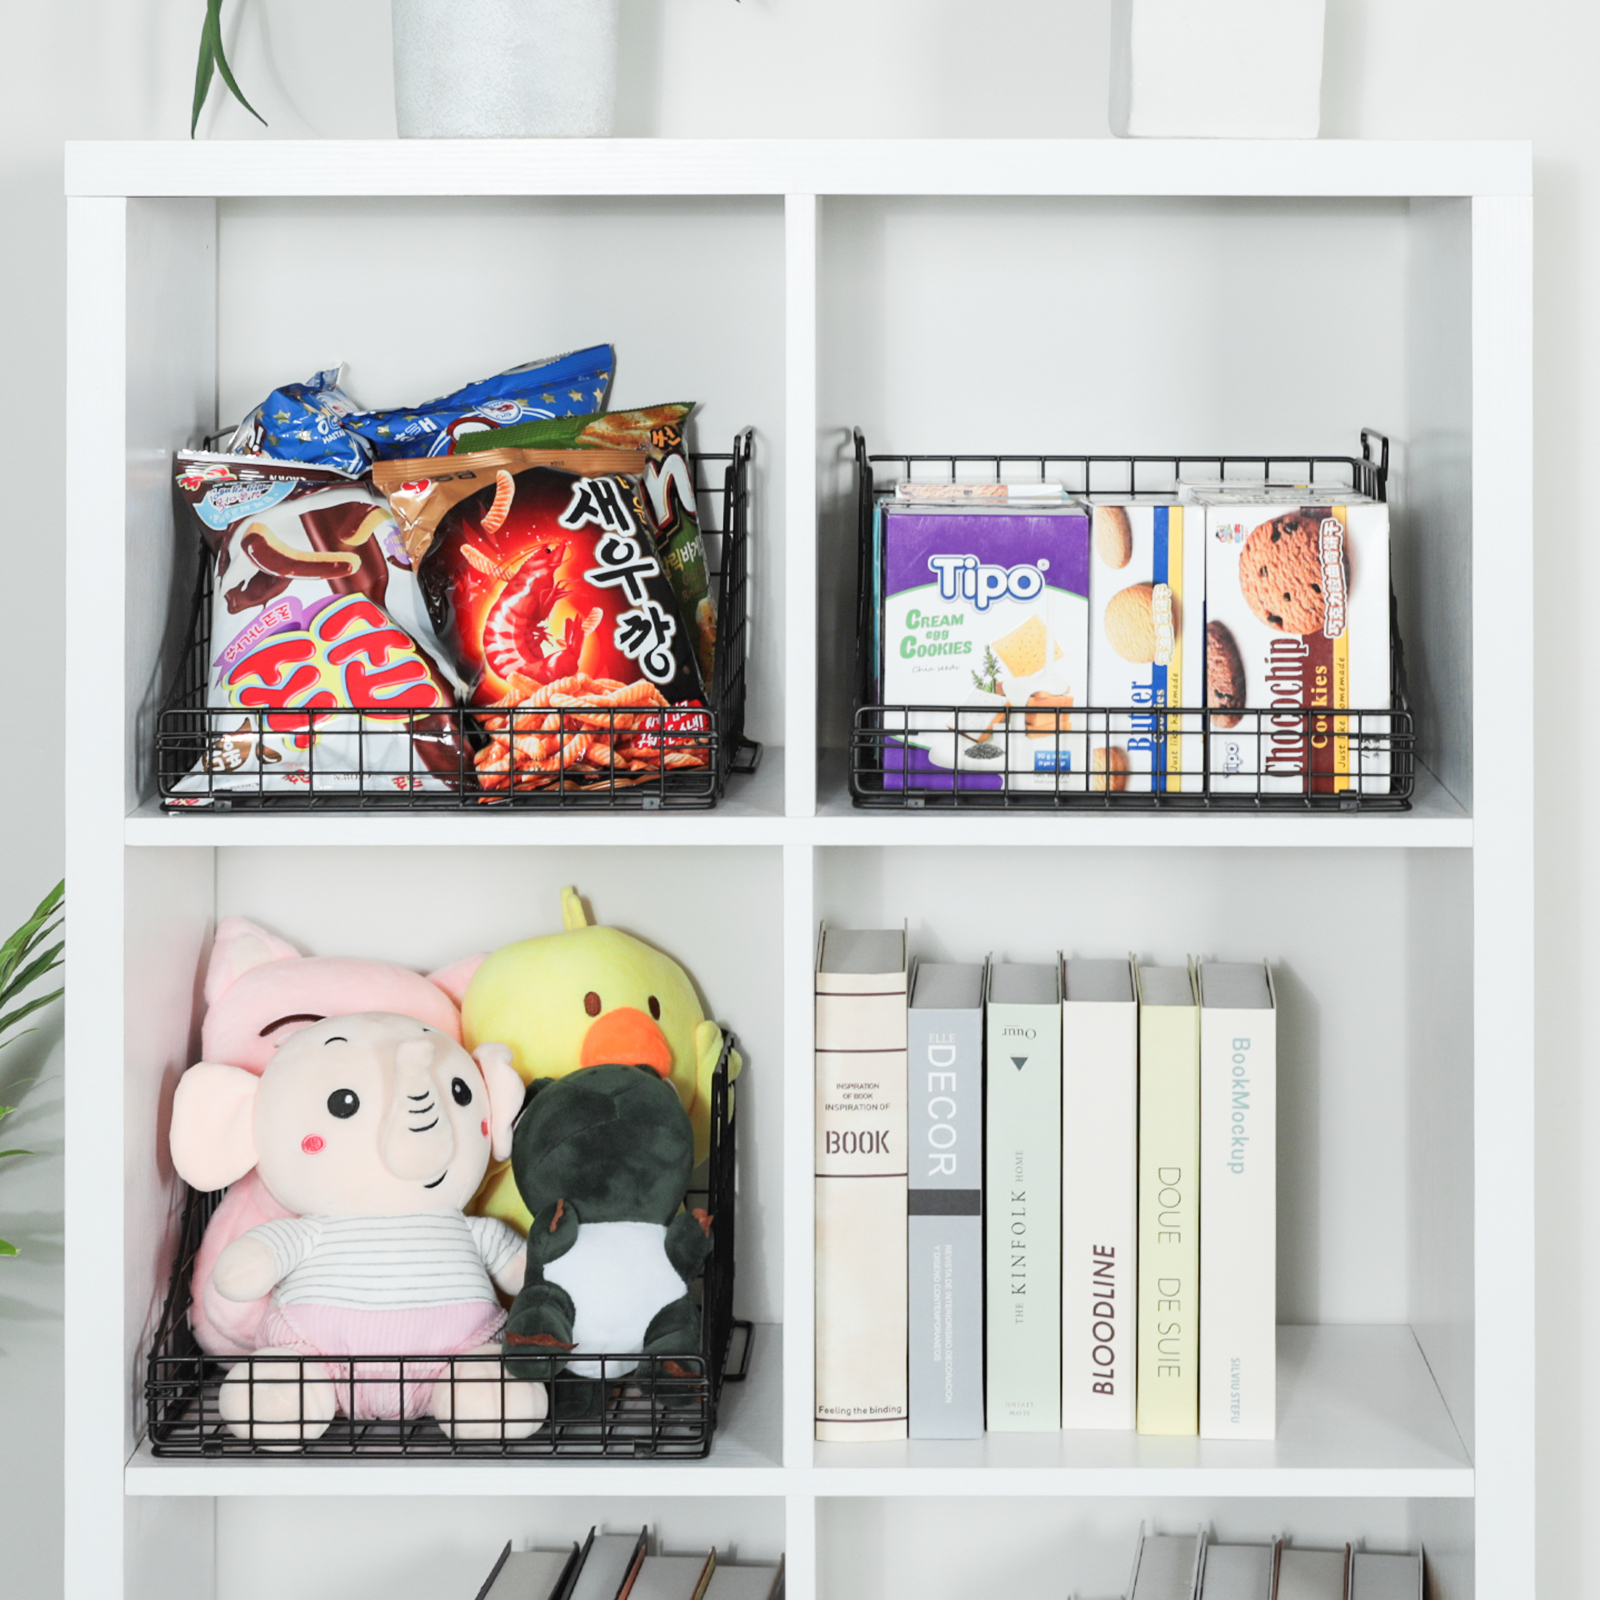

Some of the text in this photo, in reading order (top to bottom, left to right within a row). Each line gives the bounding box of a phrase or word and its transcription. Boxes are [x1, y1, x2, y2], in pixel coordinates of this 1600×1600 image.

[561, 478, 675, 683] 새우깡
[929, 555, 1044, 612] Tipo
[225, 604, 291, 660] 초코가나슈
[926, 629, 949, 640] egg
[225, 597, 442, 751] 콘초
[912, 664, 935, 673] Chia
[1337, 657, 1346, 709] omemade
[1337, 720, 1346, 739] lke
[929, 1033, 956, 1043] ELLE
[1002, 1028, 1036, 1040] Ouur
[825, 1102, 891, 1111] INSPIRATION OF
[928, 1045, 956, 1177] DECOR
[1227, 1038, 1250, 1174] BookMockup
[825, 1130, 890, 1154] BOOK
[1158, 1168, 1181, 1243] DOUE
[1011, 1150, 1026, 1324] THE KINFOLK HOME
[944, 1245, 952, 1277] REVISTA
[944, 1279, 952, 1290] DE
[1092, 1244, 1115, 1395] BLOODLINE
[818, 1405, 902, 1416] Feeling the binding
[1230, 1393, 1240, 1424] STEFU
